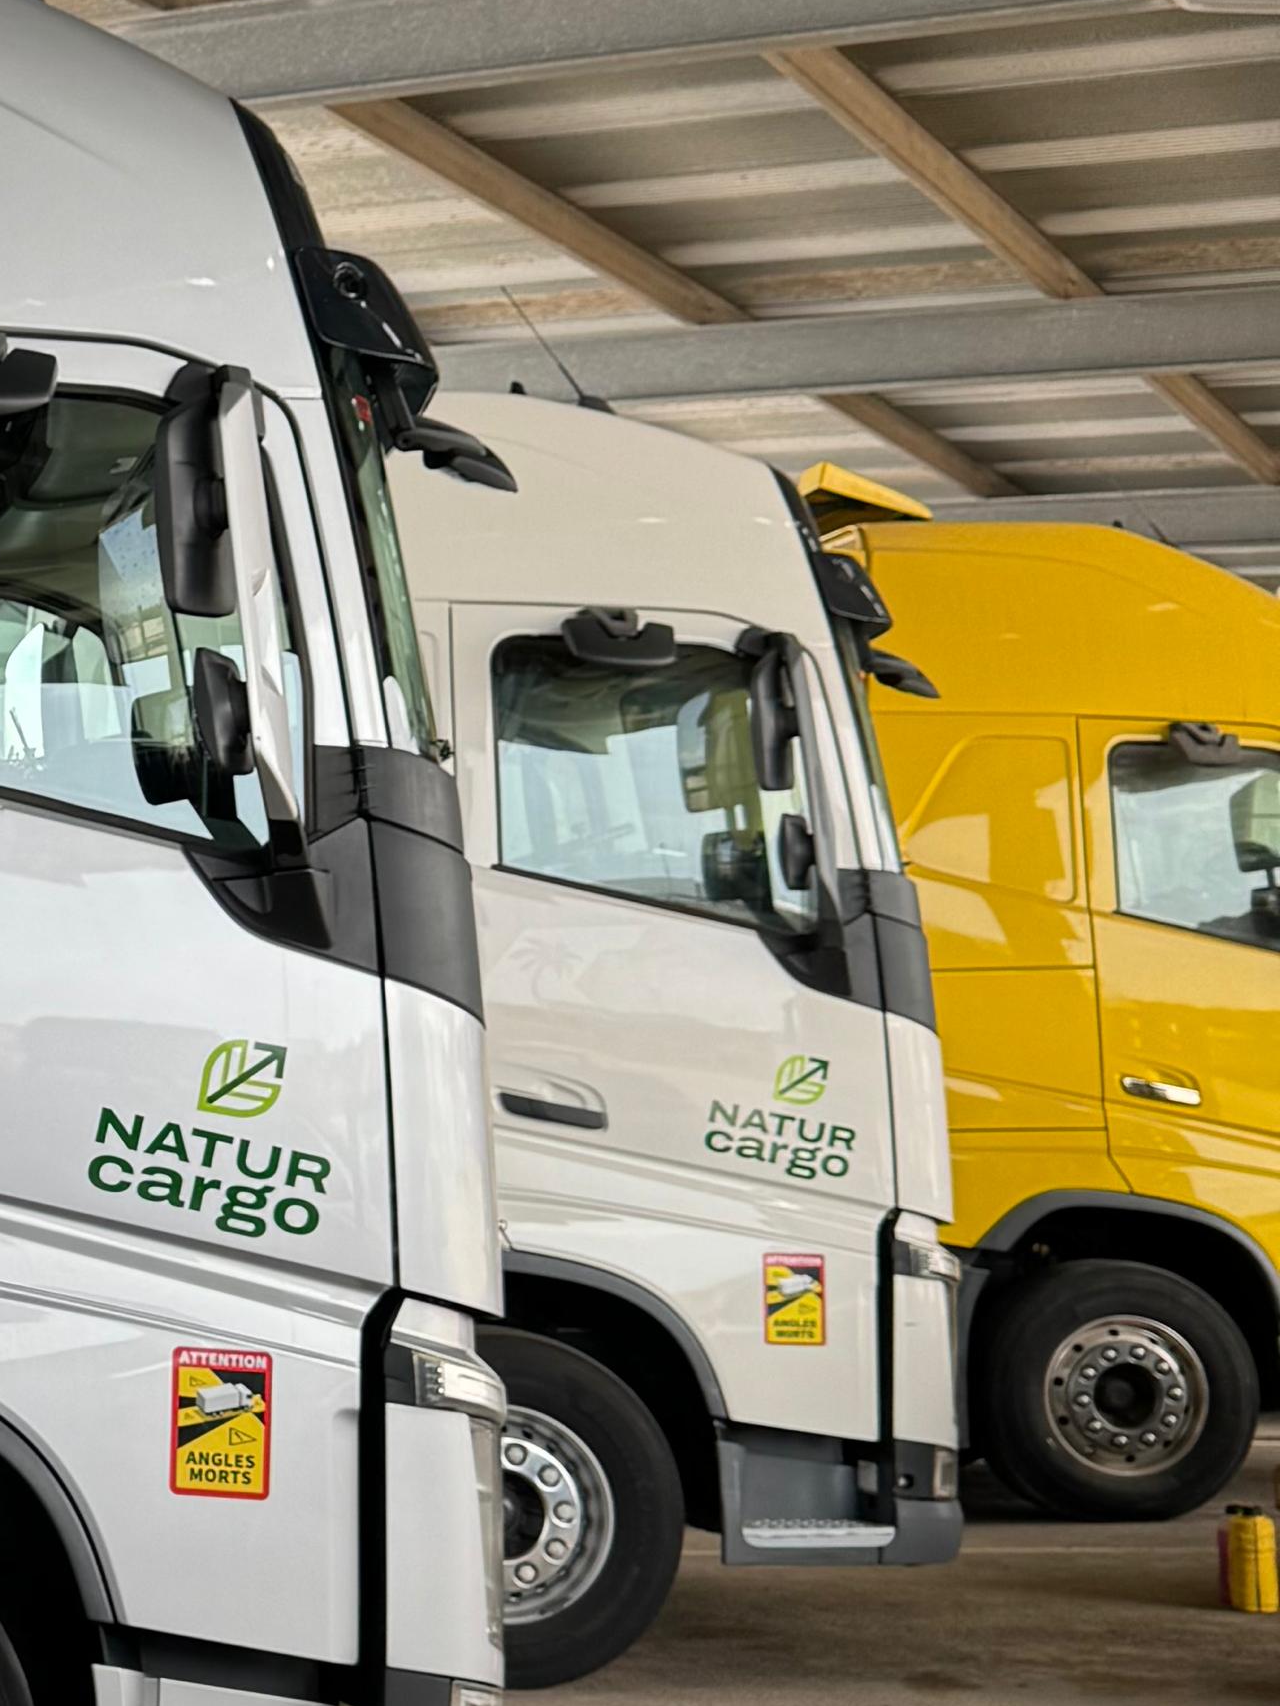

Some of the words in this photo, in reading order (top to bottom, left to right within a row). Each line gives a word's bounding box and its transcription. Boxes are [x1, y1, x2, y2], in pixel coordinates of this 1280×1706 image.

[95, 1107, 331, 1194] NATUR
[708, 1100, 856, 1151] NATUR
[704, 1130, 849, 1180] cargo
[88, 1155, 319, 1238] cargo
[178, 1350, 268, 1369] ATTENTION
[185, 1451, 256, 1469] ANGLES
[189, 1467, 252, 1485] MORTS
